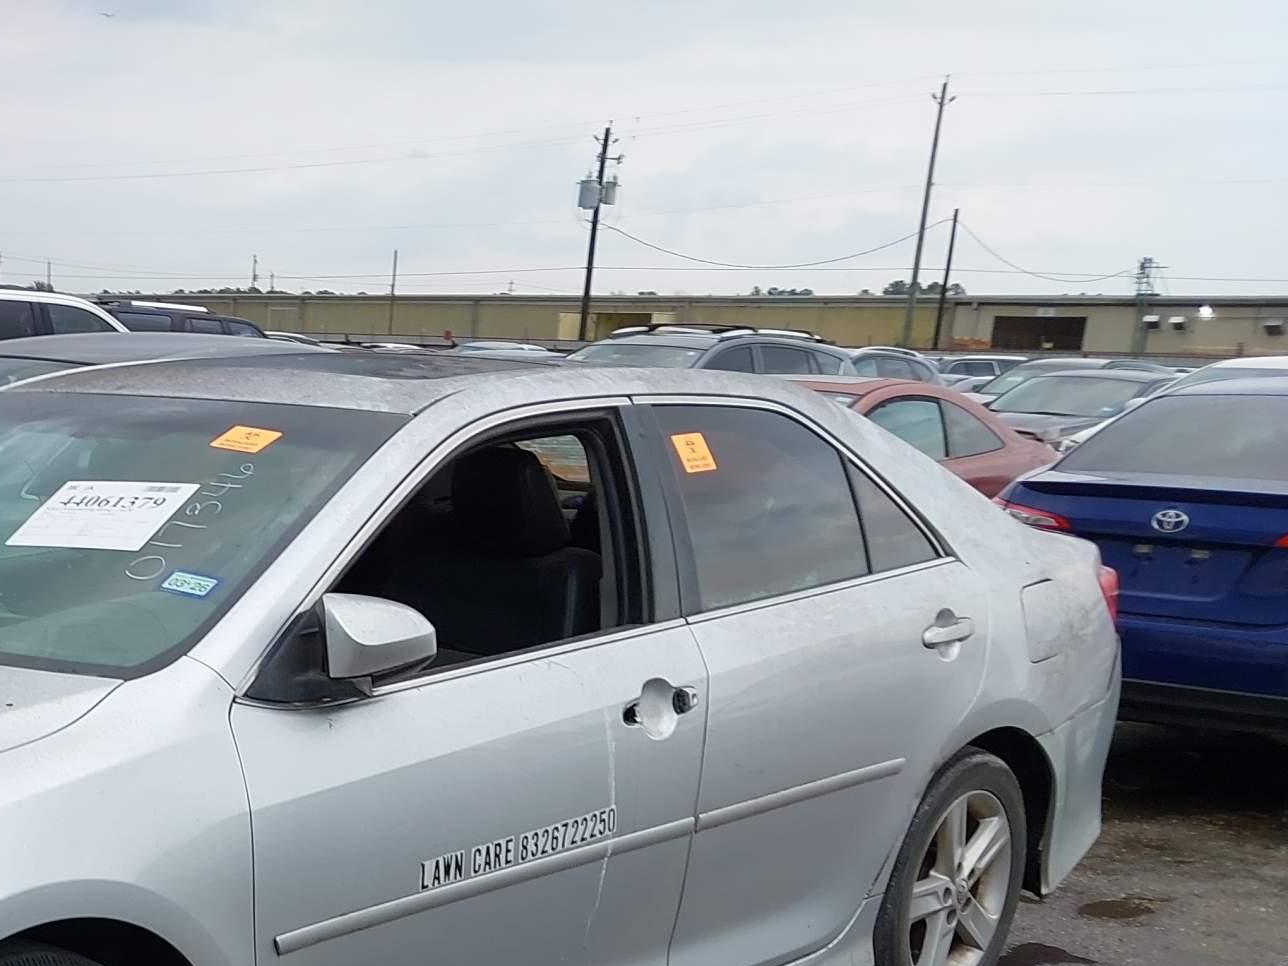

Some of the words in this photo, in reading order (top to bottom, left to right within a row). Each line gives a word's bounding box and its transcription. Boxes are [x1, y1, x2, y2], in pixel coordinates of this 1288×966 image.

[59, 495, 167, 509] 44061379
[420, 851, 464, 890] LAWN
[472, 837, 514, 874] CARE
[520, 807, 616, 861] 8326722250
